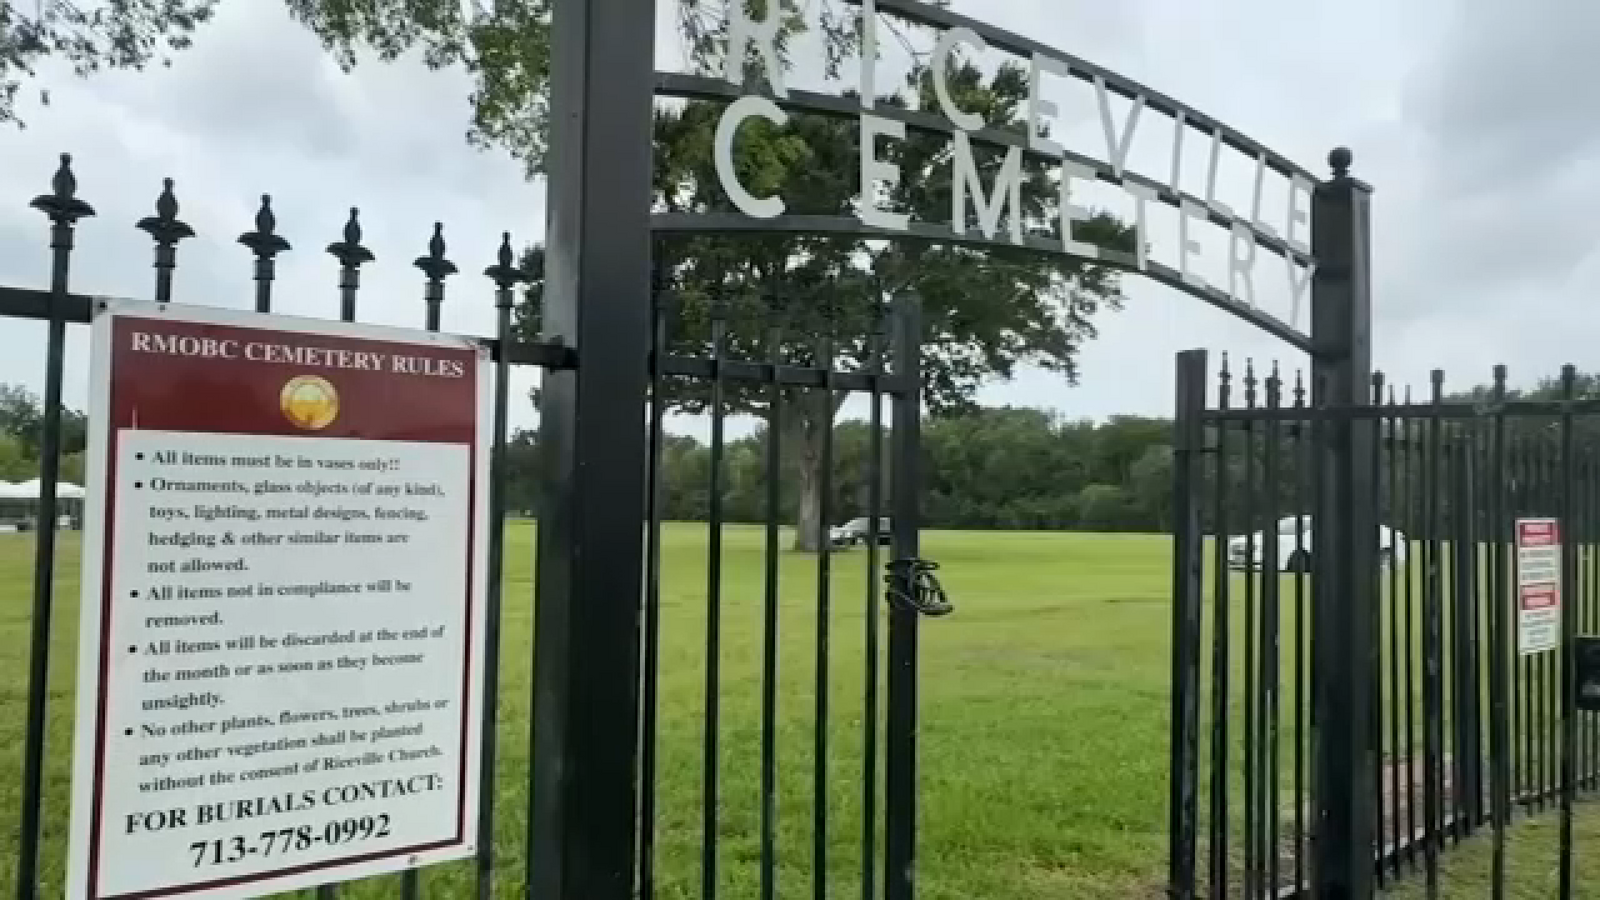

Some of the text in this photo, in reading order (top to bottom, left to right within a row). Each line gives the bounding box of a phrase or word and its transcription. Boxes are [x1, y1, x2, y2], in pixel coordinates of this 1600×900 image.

[724, 0, 1315, 252] RICEVILLE
[714, 97, 1315, 329] CEMETERY
[131, 332, 464, 377] RMOBC CEMETERY RULES
[151, 451, 400, 473] All items must be in vases only!!
[149, 478, 250, 494] Ornaments,
[254, 481, 291, 496] glass
[295, 482, 348, 496] objects
[351, 482, 373, 496] (of
[376, 485, 400, 497] any
[149, 505, 428, 521] toys, lighting, metal designs, fencing,
[148, 531, 409, 548] hedging & other similar items are
[147, 558, 250, 573] not allowed.
[147, 580, 411, 600] All items not in compliance will be
[145, 610, 223, 628] removed.
[145, 625, 445, 655] All items will be discarded at the end of
[142, 652, 423, 683] the month or as soon as they become
[142, 692, 225, 712] unsightly.
[142, 724, 166, 737] No
[170, 720, 215, 735] other
[222, 715, 275, 733] plants,
[279, 710, 338, 726] flowers,
[384, 699, 430, 715] shrubs
[434, 698, 448, 709] or
[139, 723, 423, 768] any other vegetation shall be planted
[139, 746, 442, 793] without the consent of Riceville Church.
[125, 775, 443, 834] FOR BURIALS CONTACT:
[189, 814, 391, 868] 713-778-0992
